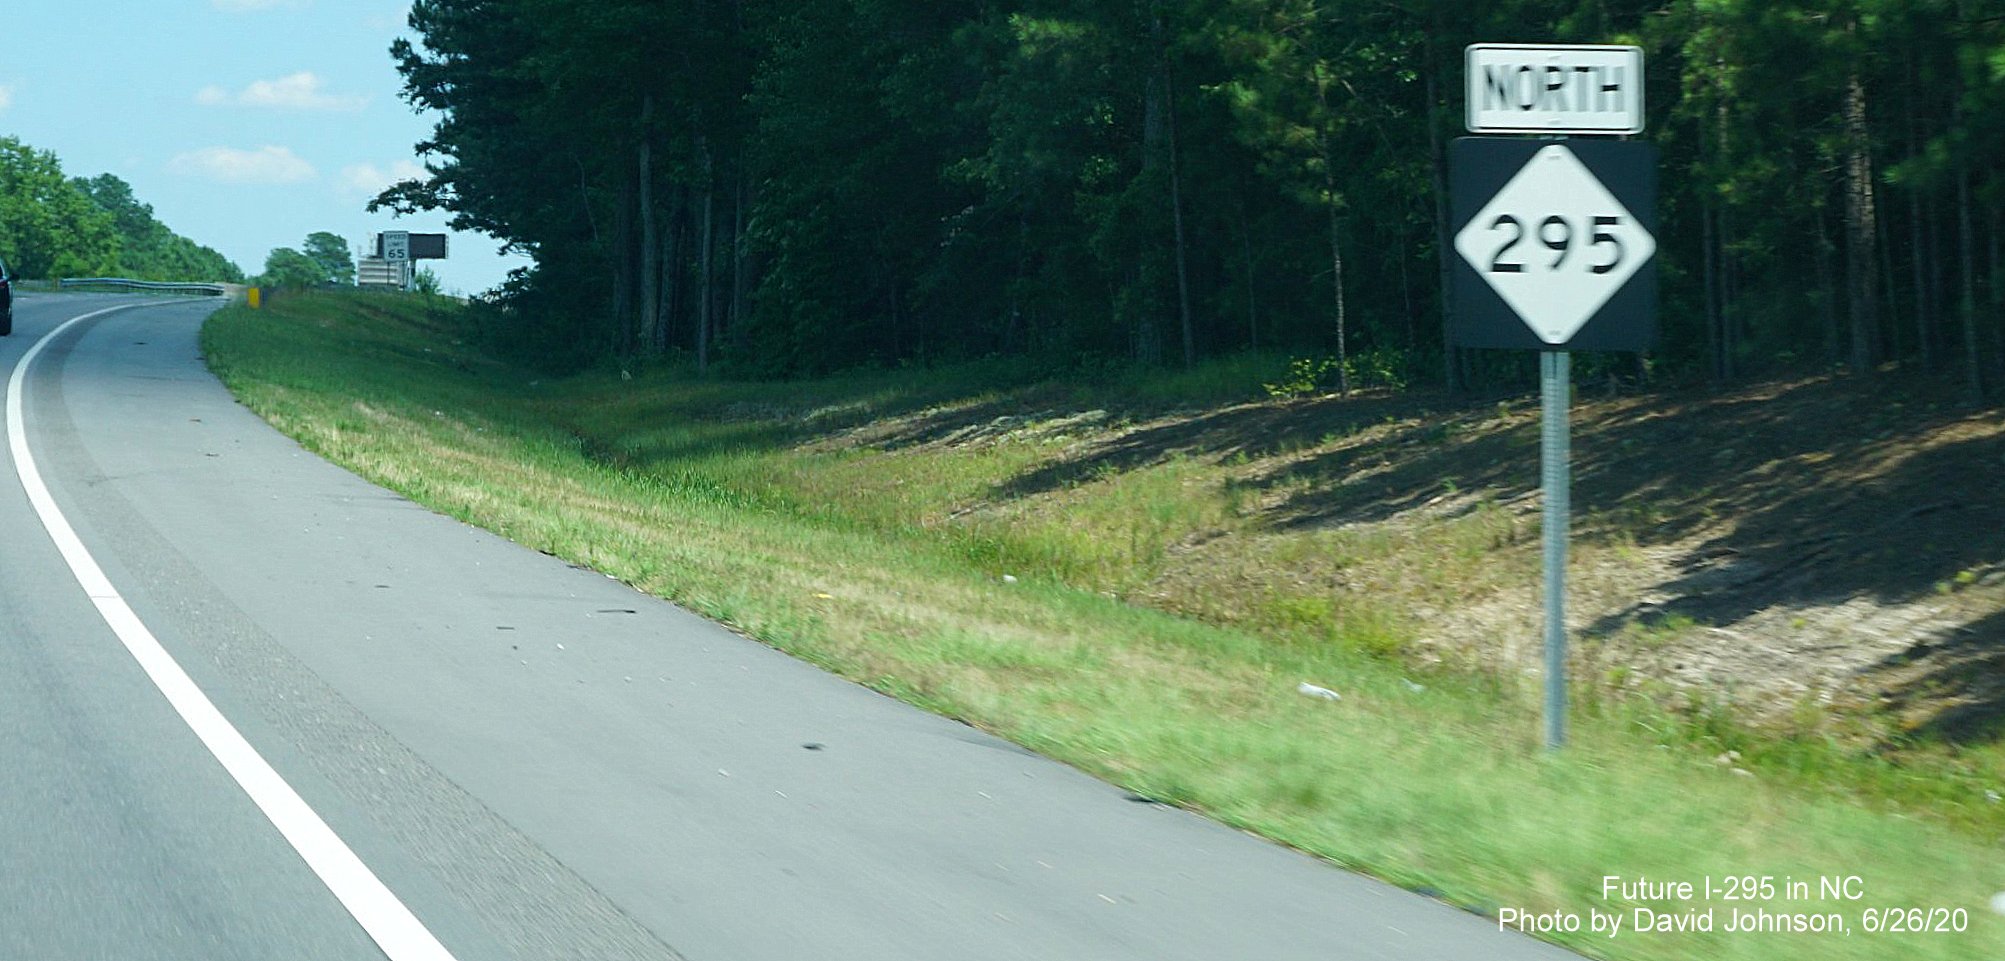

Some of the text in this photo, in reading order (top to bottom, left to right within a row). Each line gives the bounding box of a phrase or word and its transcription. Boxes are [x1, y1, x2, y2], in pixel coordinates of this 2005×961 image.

[1482, 64, 1626, 113] NORTH
[388, 249, 405, 258] 65
[1488, 214, 1624, 274] 295
